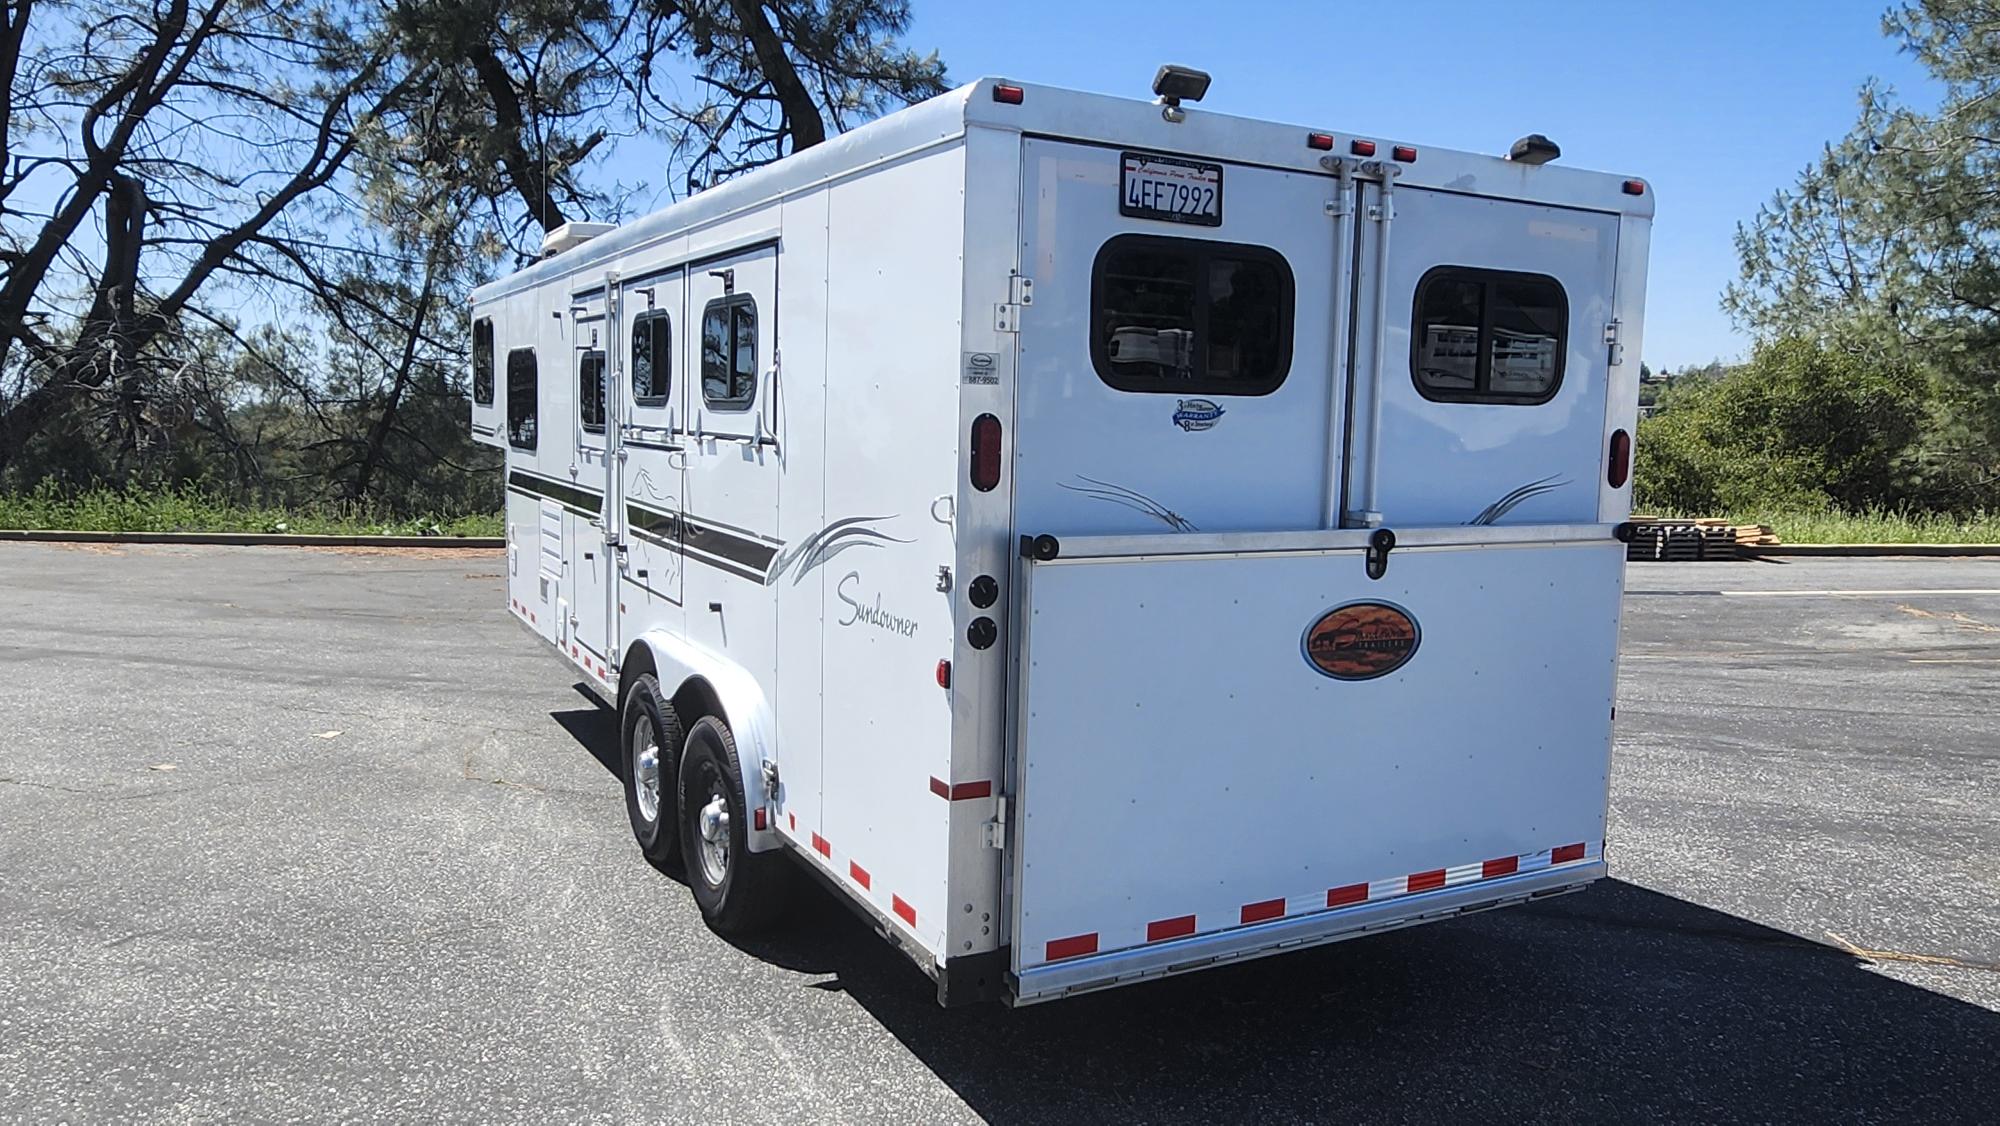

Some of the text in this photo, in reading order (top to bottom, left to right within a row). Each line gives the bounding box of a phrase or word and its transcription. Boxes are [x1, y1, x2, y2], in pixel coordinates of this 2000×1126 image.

[1128, 178, 1214, 216] 4EF7992
[1177, 399, 1183, 412] 3
[1184, 420, 1190, 432] 8
[838, 570, 918, 639] Sundowner
